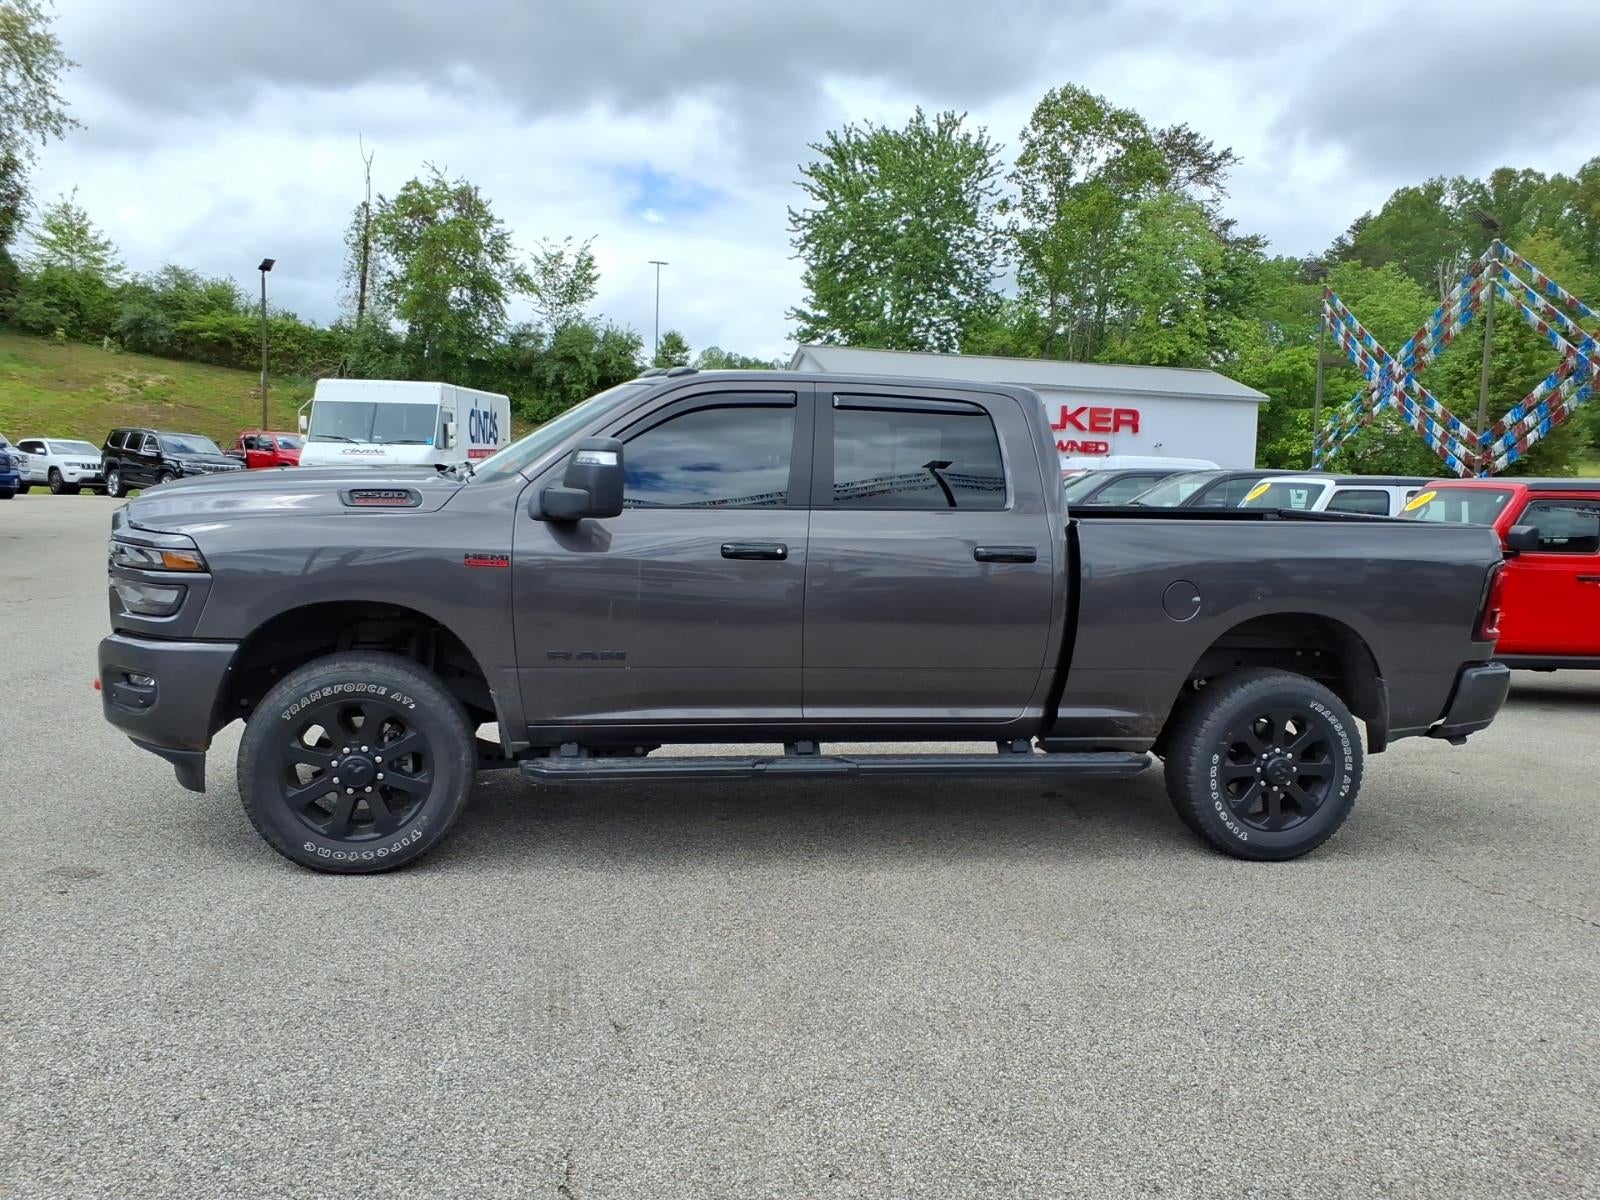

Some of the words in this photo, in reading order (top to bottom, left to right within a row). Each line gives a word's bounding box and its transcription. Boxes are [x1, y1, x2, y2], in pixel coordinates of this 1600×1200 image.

[469, 398, 498, 445] CINTAS
[353, 491, 407, 499] 2500
[464, 552, 509, 561] HEMI
[546, 650, 626, 661] RAM
[281, 683, 388, 721] TRANSFORCE
[1309, 700, 1353, 771] TRANSFORCE
